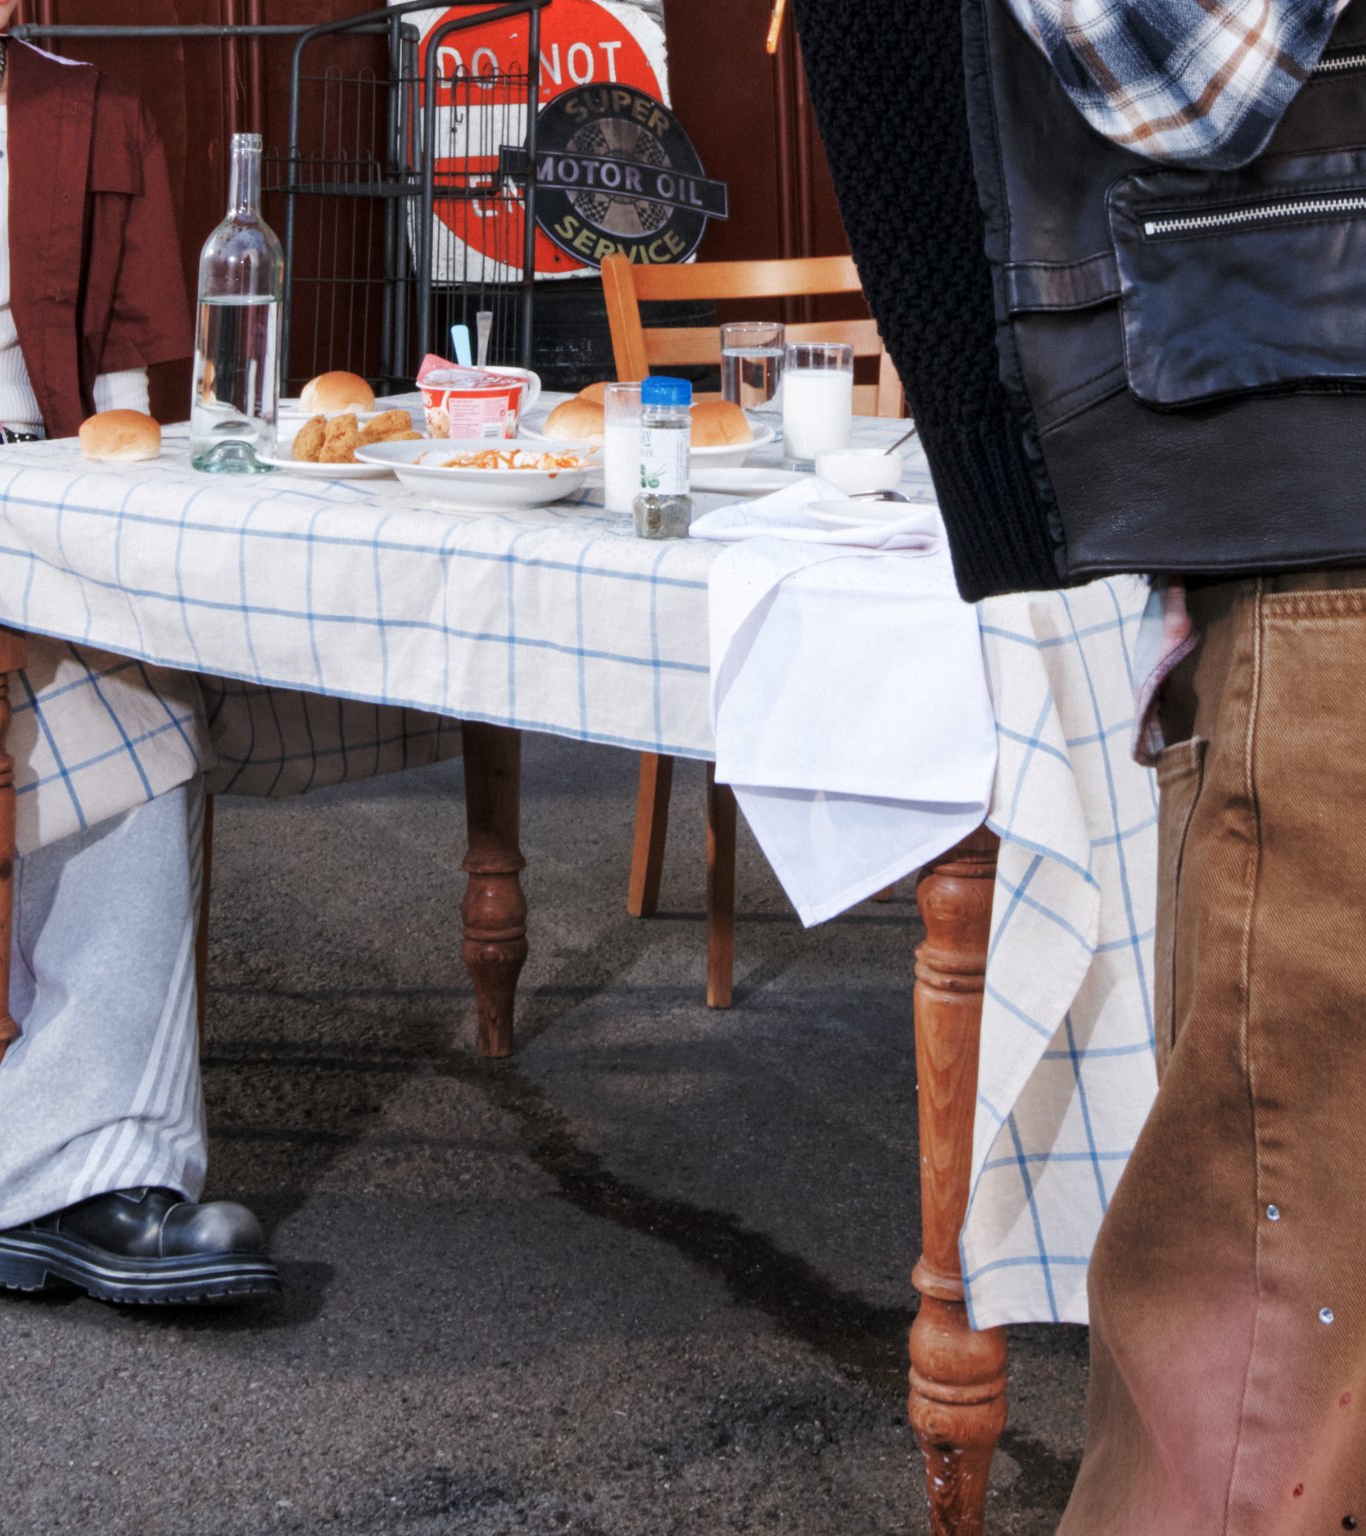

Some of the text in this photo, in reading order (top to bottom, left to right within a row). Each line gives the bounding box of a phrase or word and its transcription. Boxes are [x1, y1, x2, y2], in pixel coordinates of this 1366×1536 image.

[436, 40, 622, 90] DO NOT
[565, 89, 671, 137] SUPER
[536, 156, 703, 207] MOTOR OIL
[554, 215, 687, 265] SERVICE
